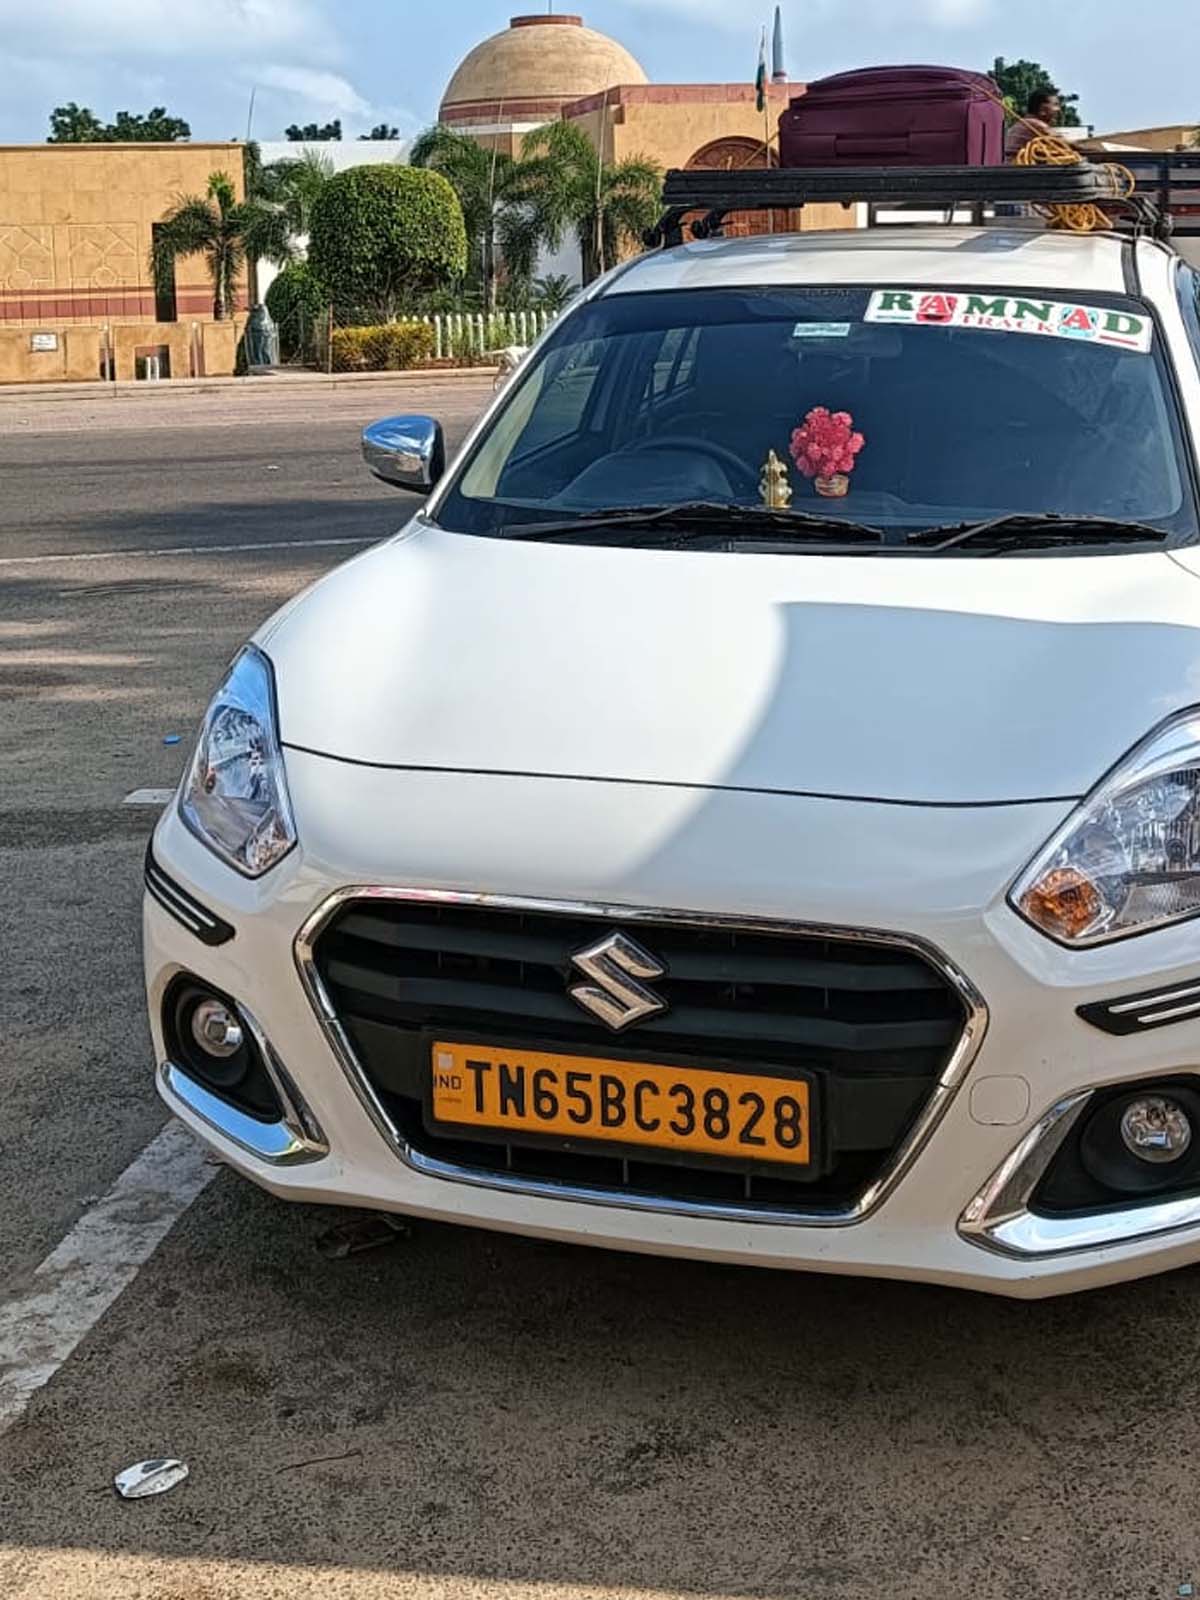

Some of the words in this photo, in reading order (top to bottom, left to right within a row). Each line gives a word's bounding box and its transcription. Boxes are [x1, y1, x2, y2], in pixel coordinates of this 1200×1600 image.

[877, 292, 1143, 336] RAMNAD
[434, 1074, 462, 1090] IND
[465, 1059, 802, 1149] TN65BC3828
